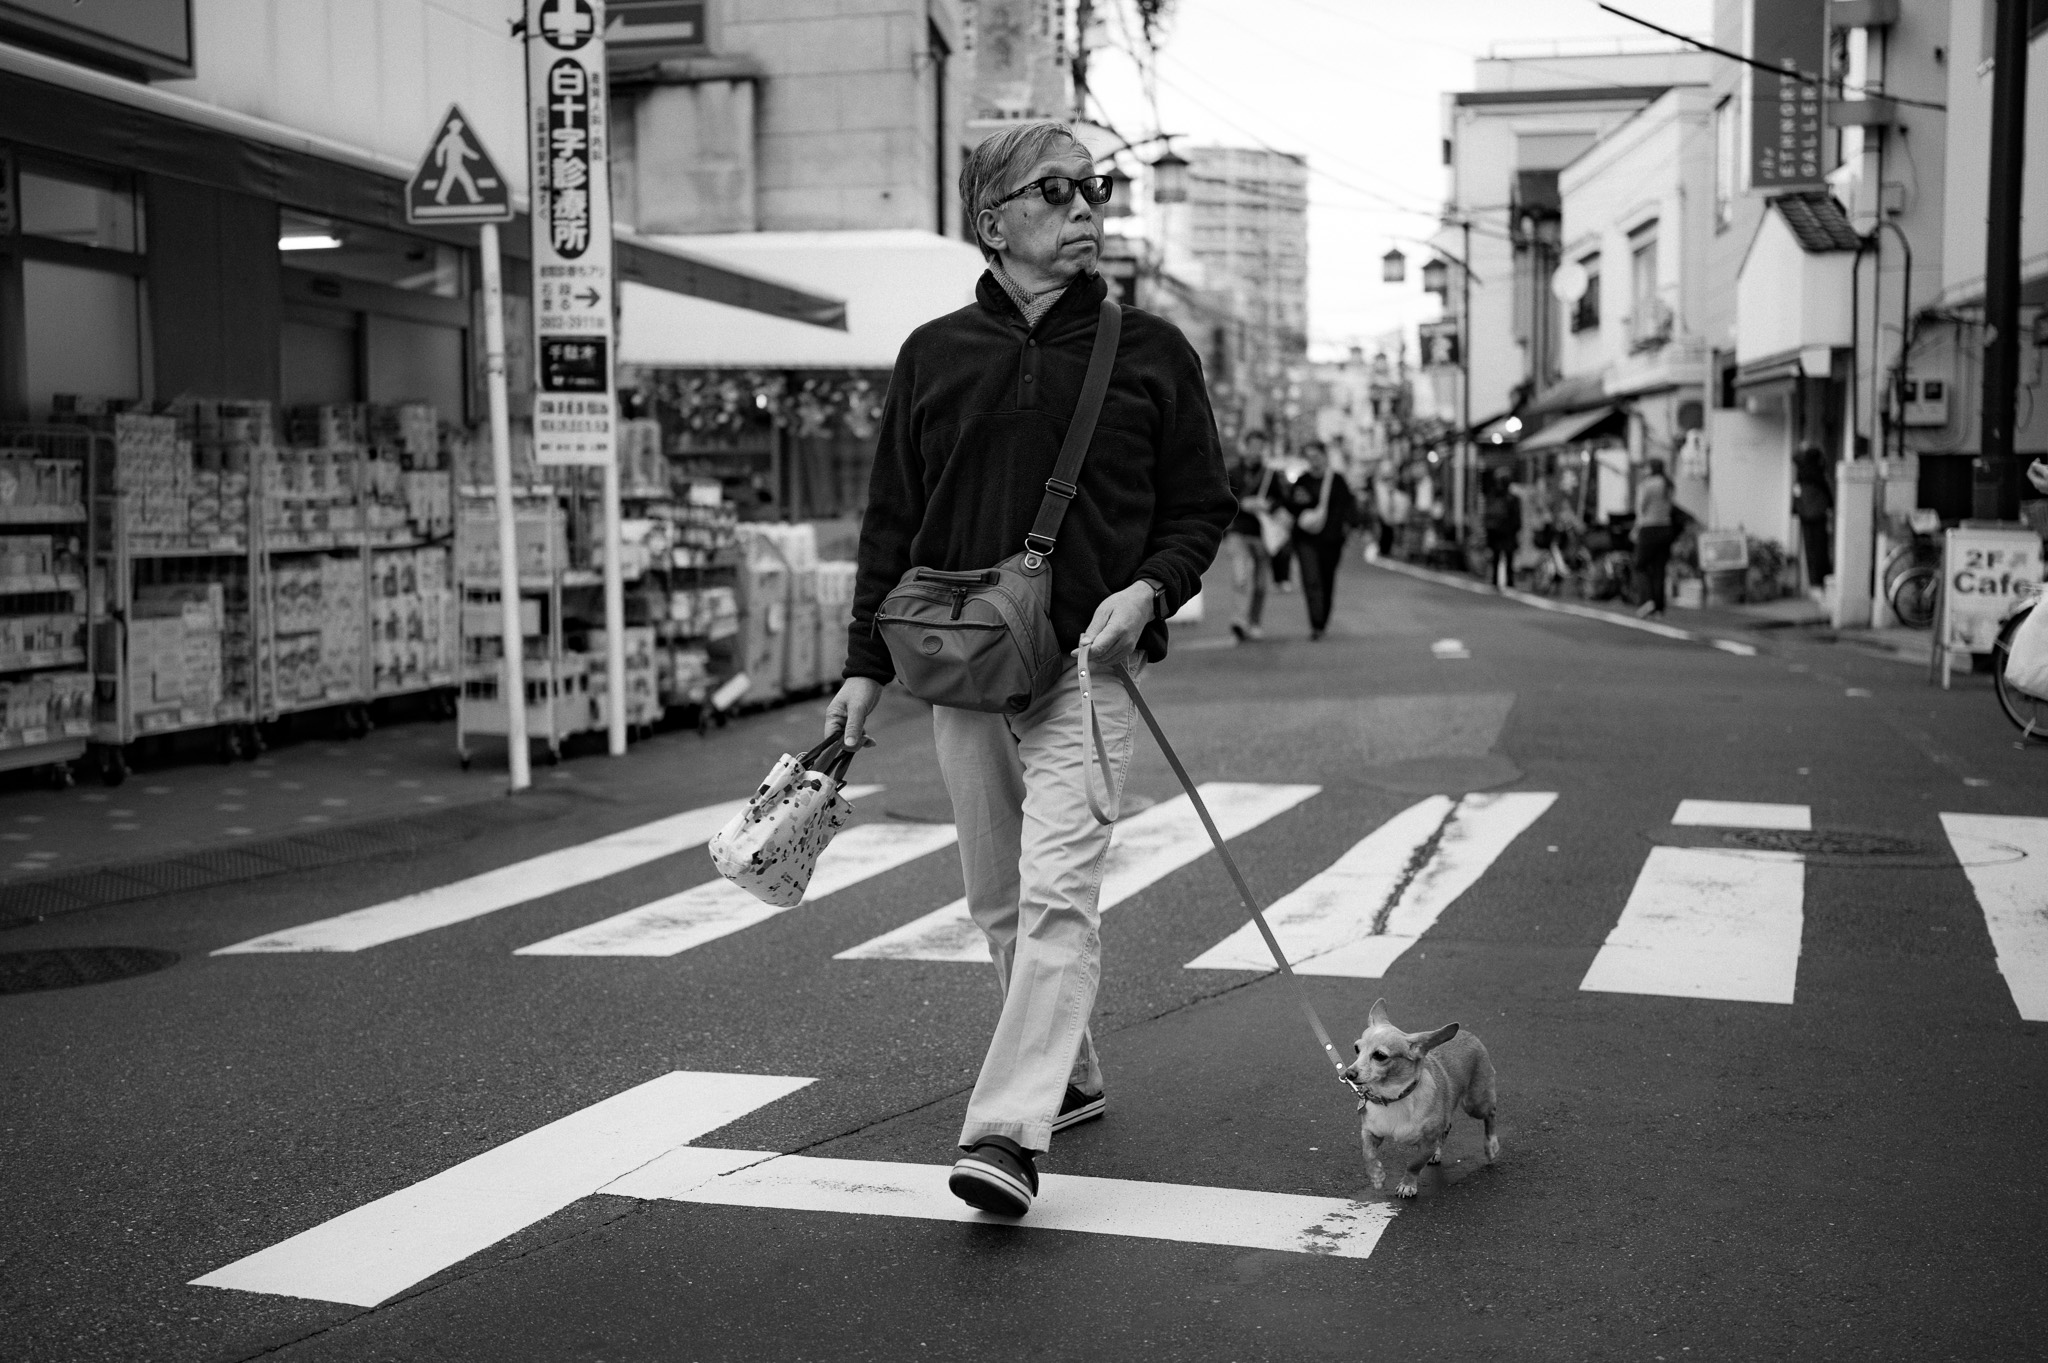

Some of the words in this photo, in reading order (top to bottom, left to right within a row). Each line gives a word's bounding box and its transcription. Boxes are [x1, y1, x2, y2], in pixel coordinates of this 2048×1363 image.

[551, 65, 586, 251] 白十字診療所
[1965, 549, 2004, 568] 2F
